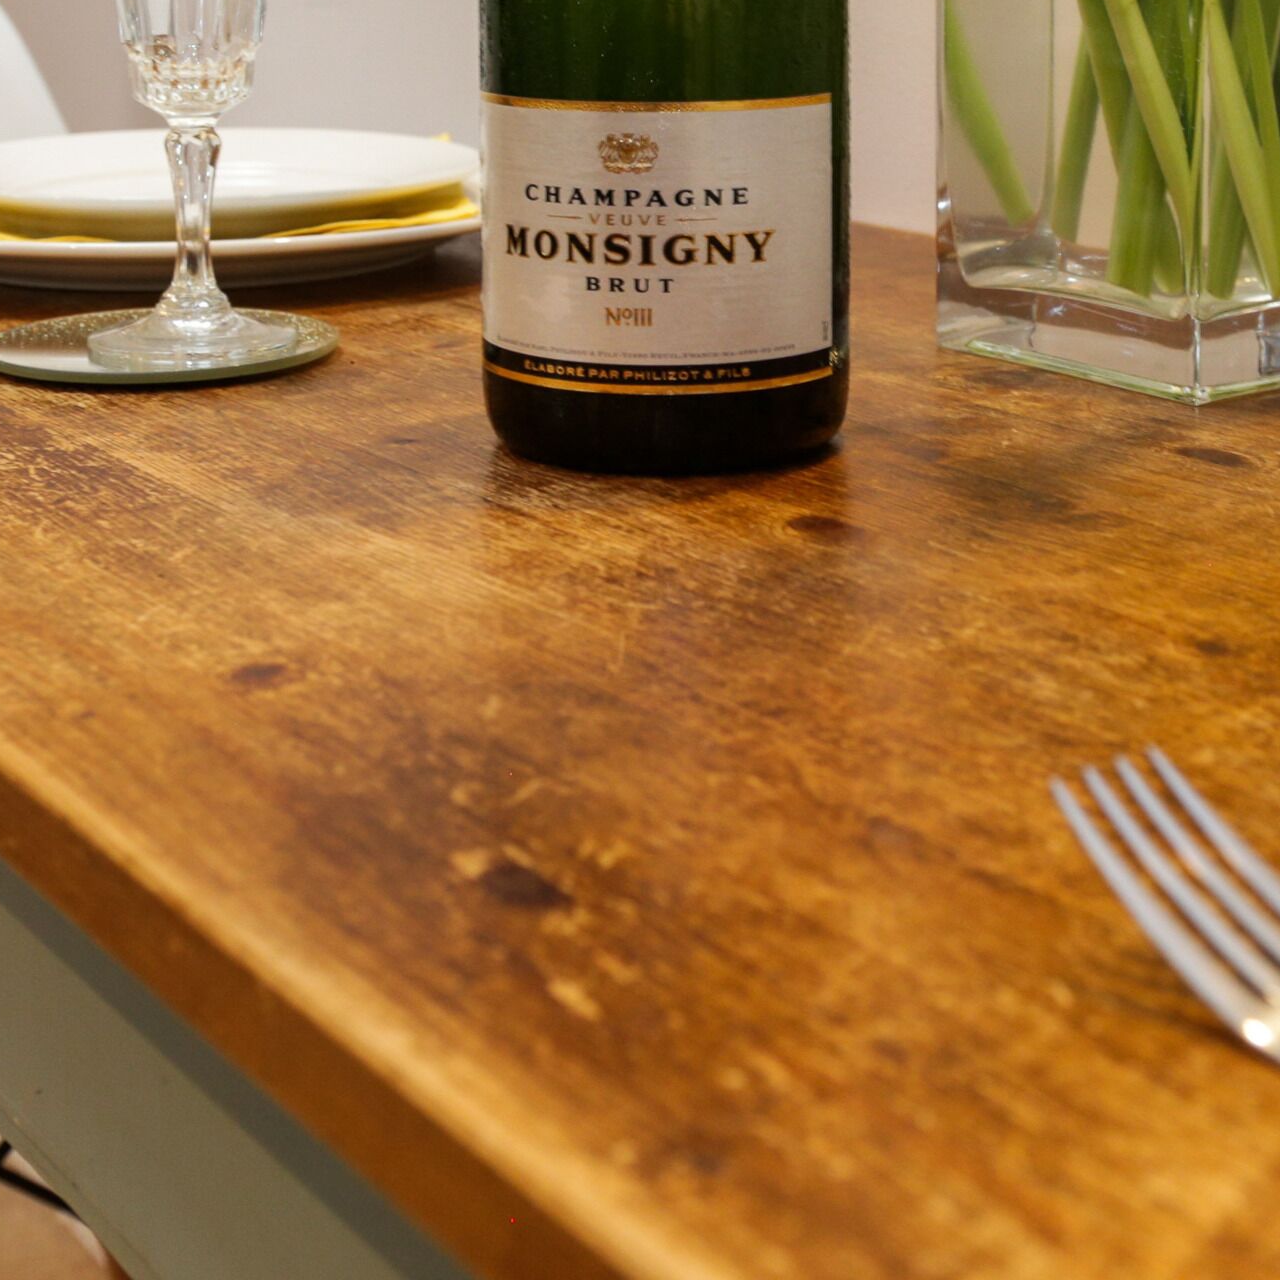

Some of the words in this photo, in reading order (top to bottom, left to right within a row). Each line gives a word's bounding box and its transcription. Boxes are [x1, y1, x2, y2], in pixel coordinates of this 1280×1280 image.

[524, 183, 749, 208] CHAMPAGNE
[588, 213, 667, 227] VEUVE
[505, 223, 777, 267] MONSIGNY
[585, 276, 675, 294] BRUT
[587, 368, 619, 380] PAR
[623, 369, 699, 381] PHILIZOT
